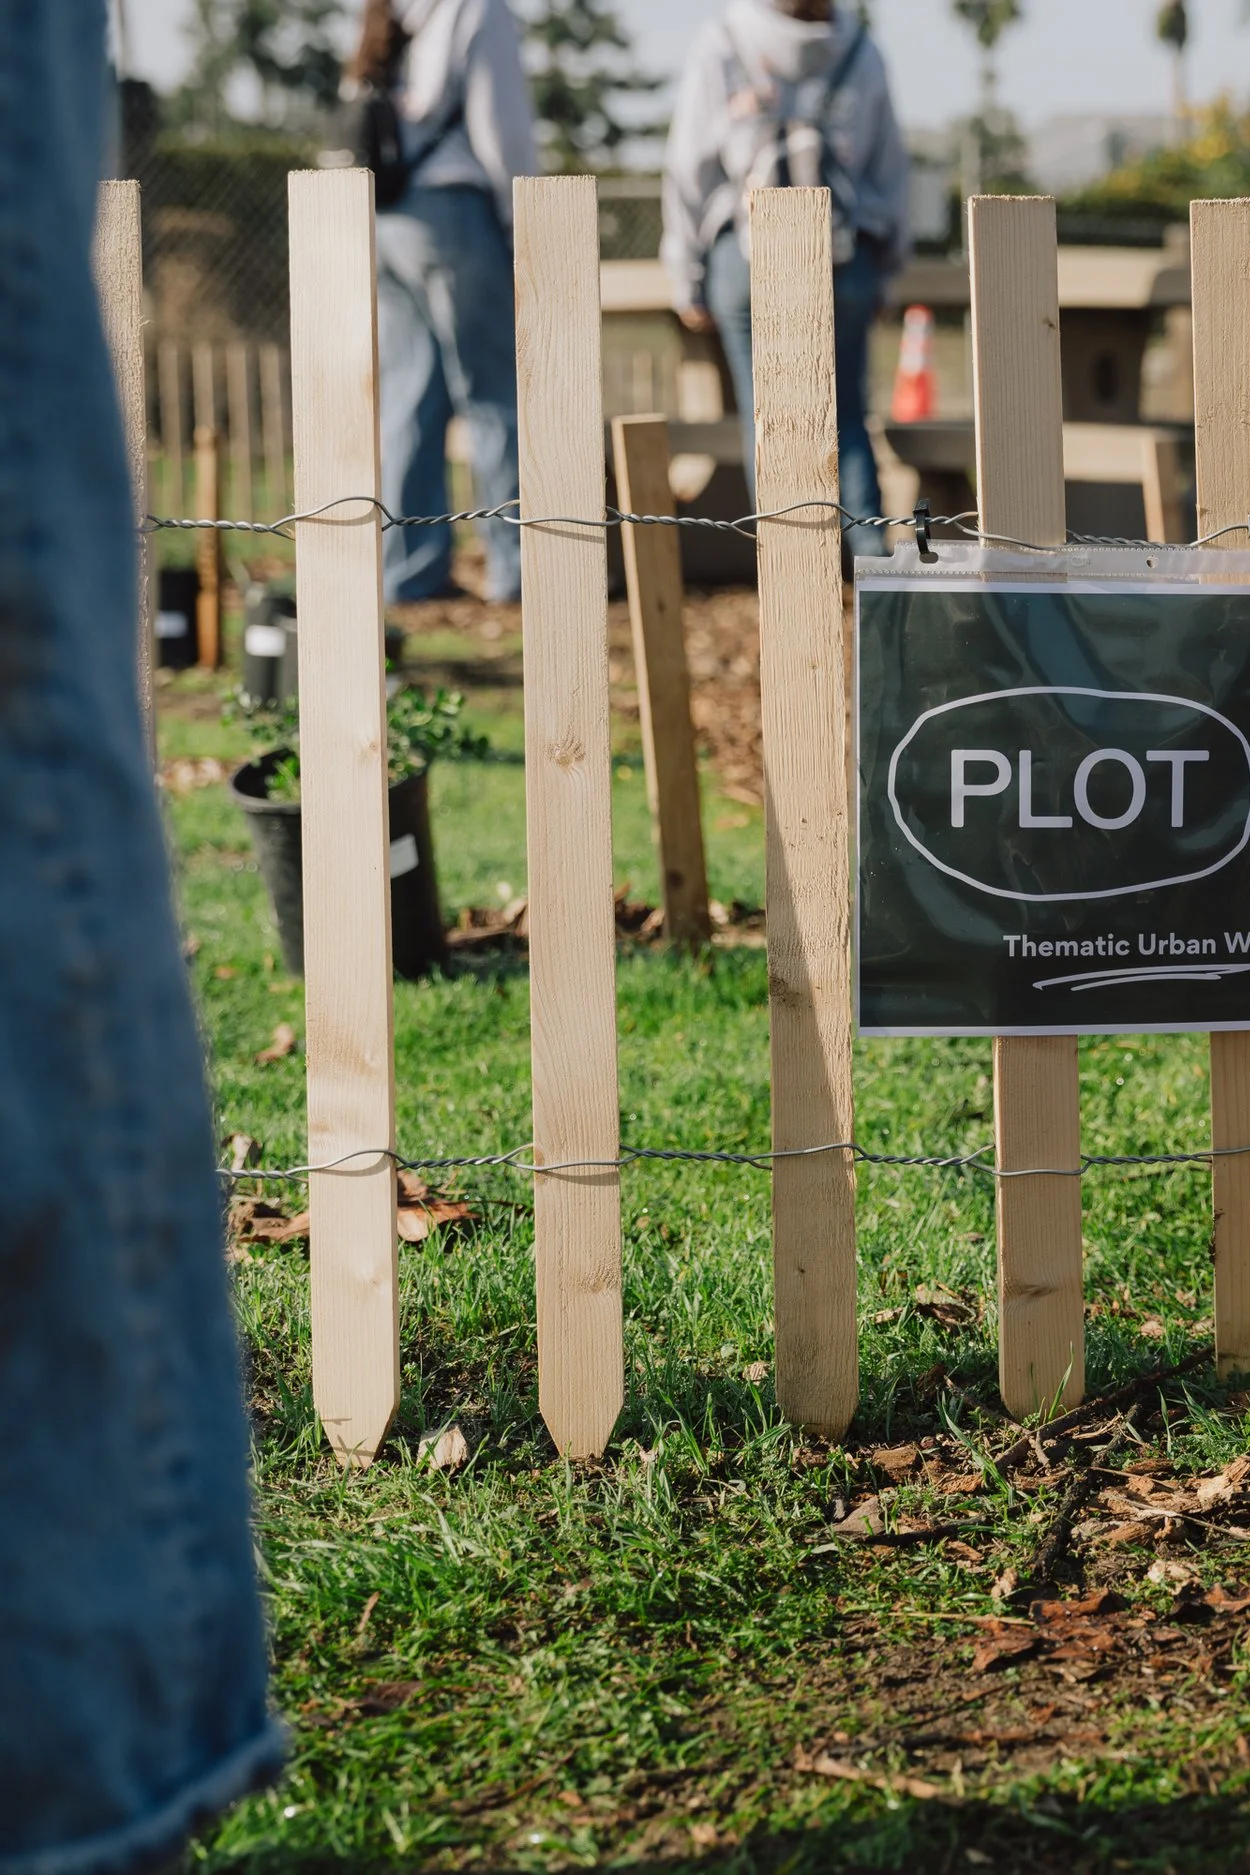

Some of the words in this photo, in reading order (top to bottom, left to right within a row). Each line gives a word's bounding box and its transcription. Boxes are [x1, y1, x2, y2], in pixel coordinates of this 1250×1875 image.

[950, 748, 1210, 830] PLOT
[1002, 933, 1130, 957] Thematic
[1138, 932, 1216, 955] Urban
